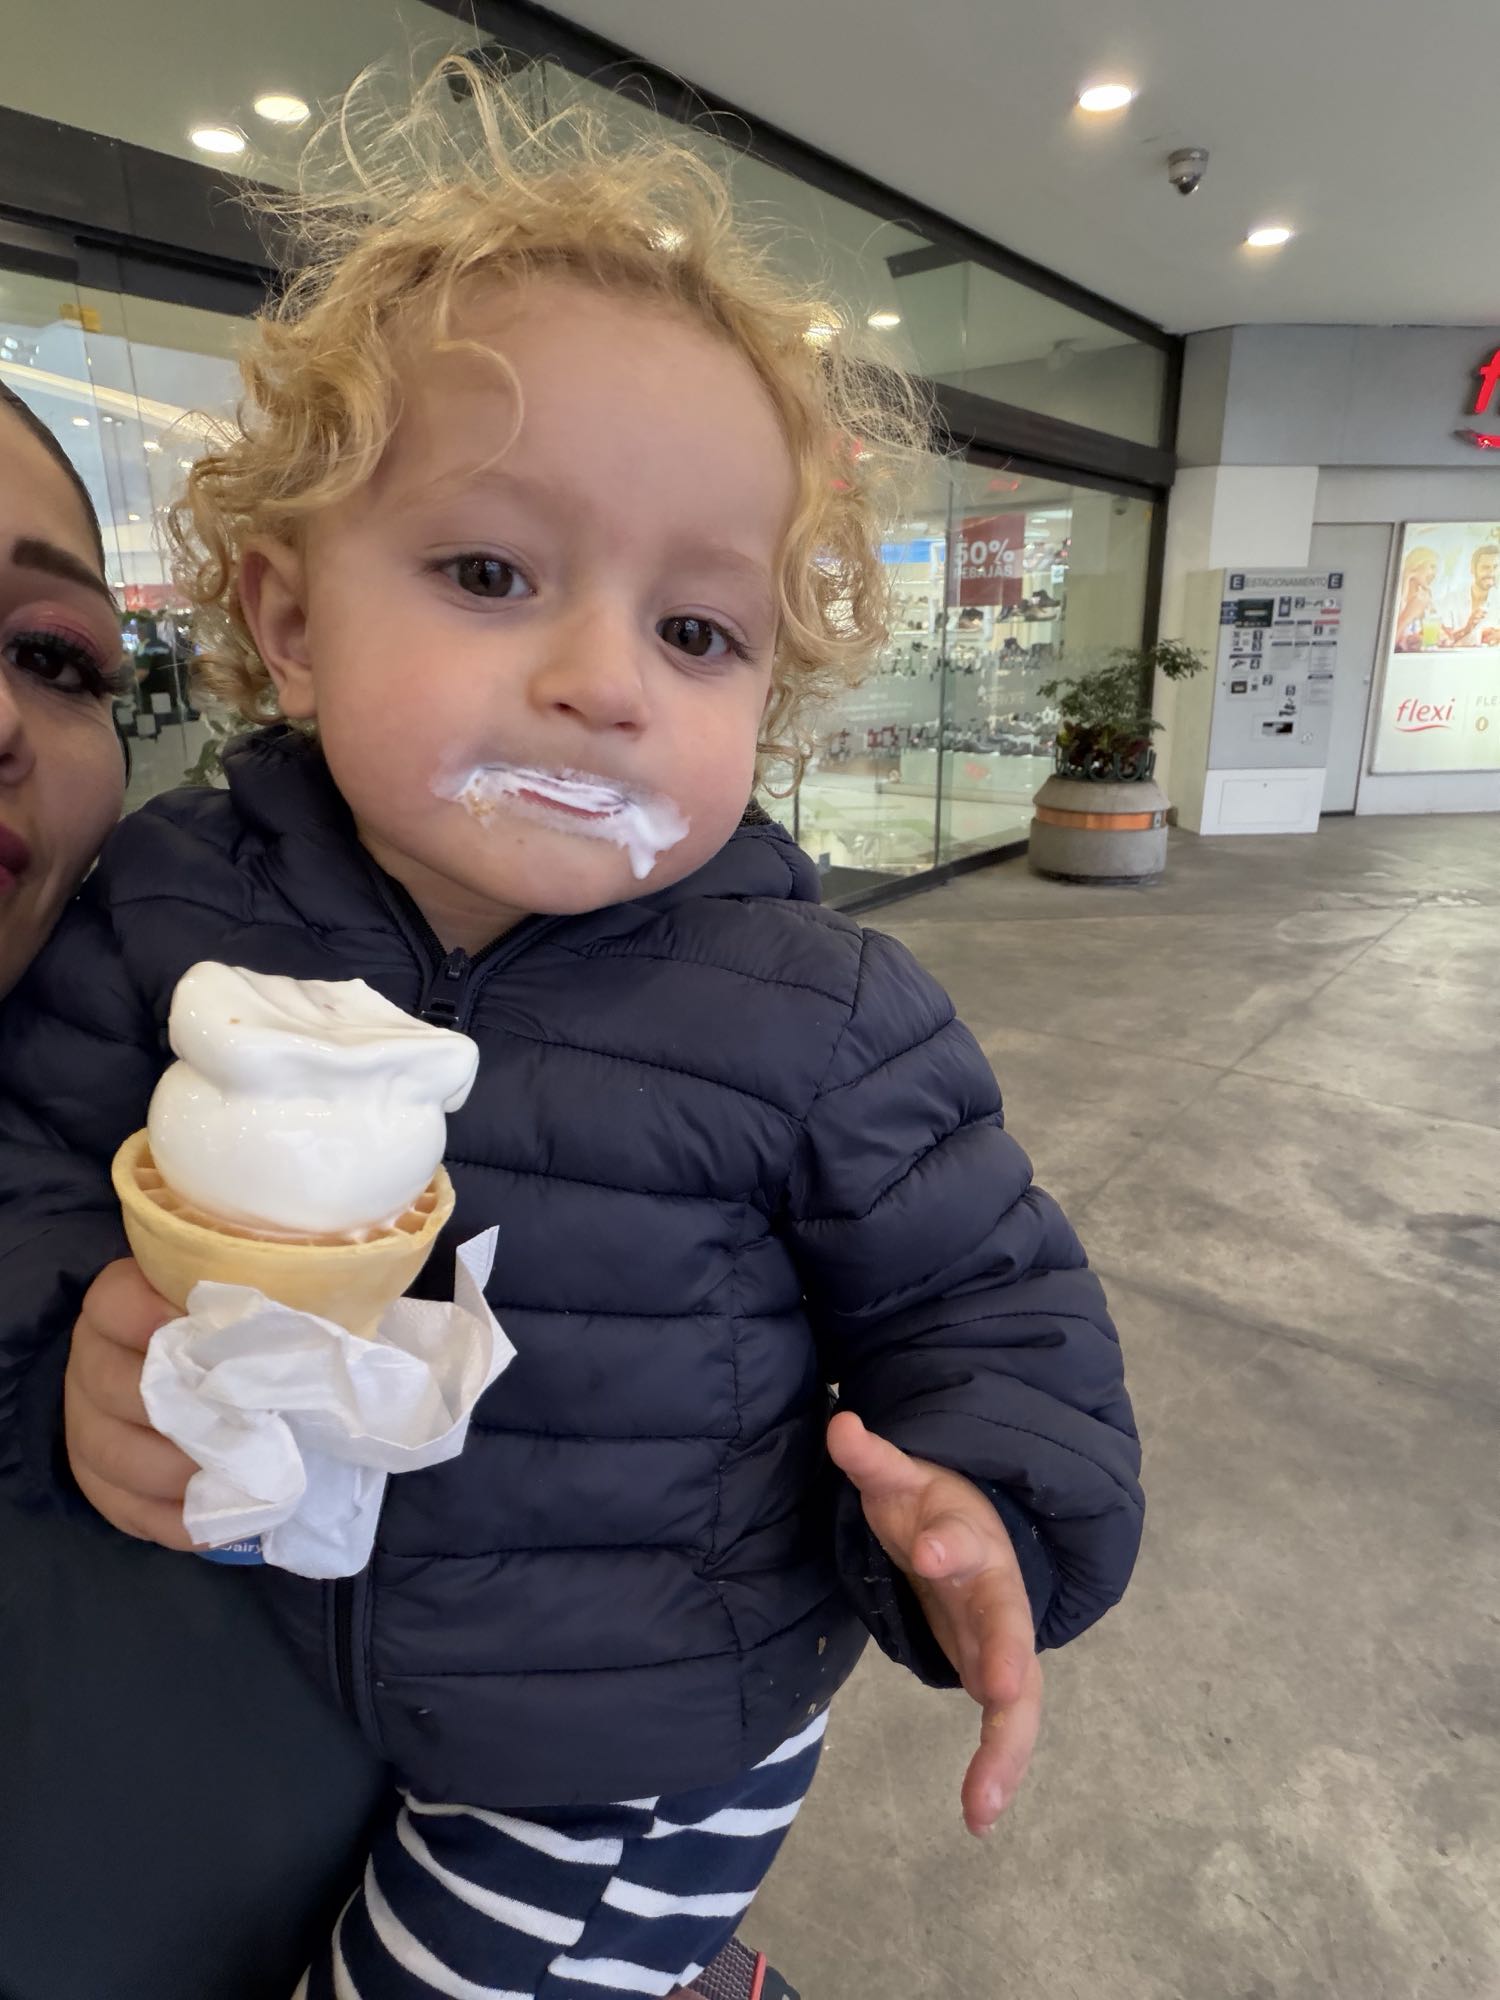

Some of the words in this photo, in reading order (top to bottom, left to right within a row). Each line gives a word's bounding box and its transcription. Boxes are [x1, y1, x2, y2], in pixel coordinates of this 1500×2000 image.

[953, 538, 1015, 565] 50%
[1395, 697, 1456, 722] flexi
[1475, 695, 1500, 707] FLE
